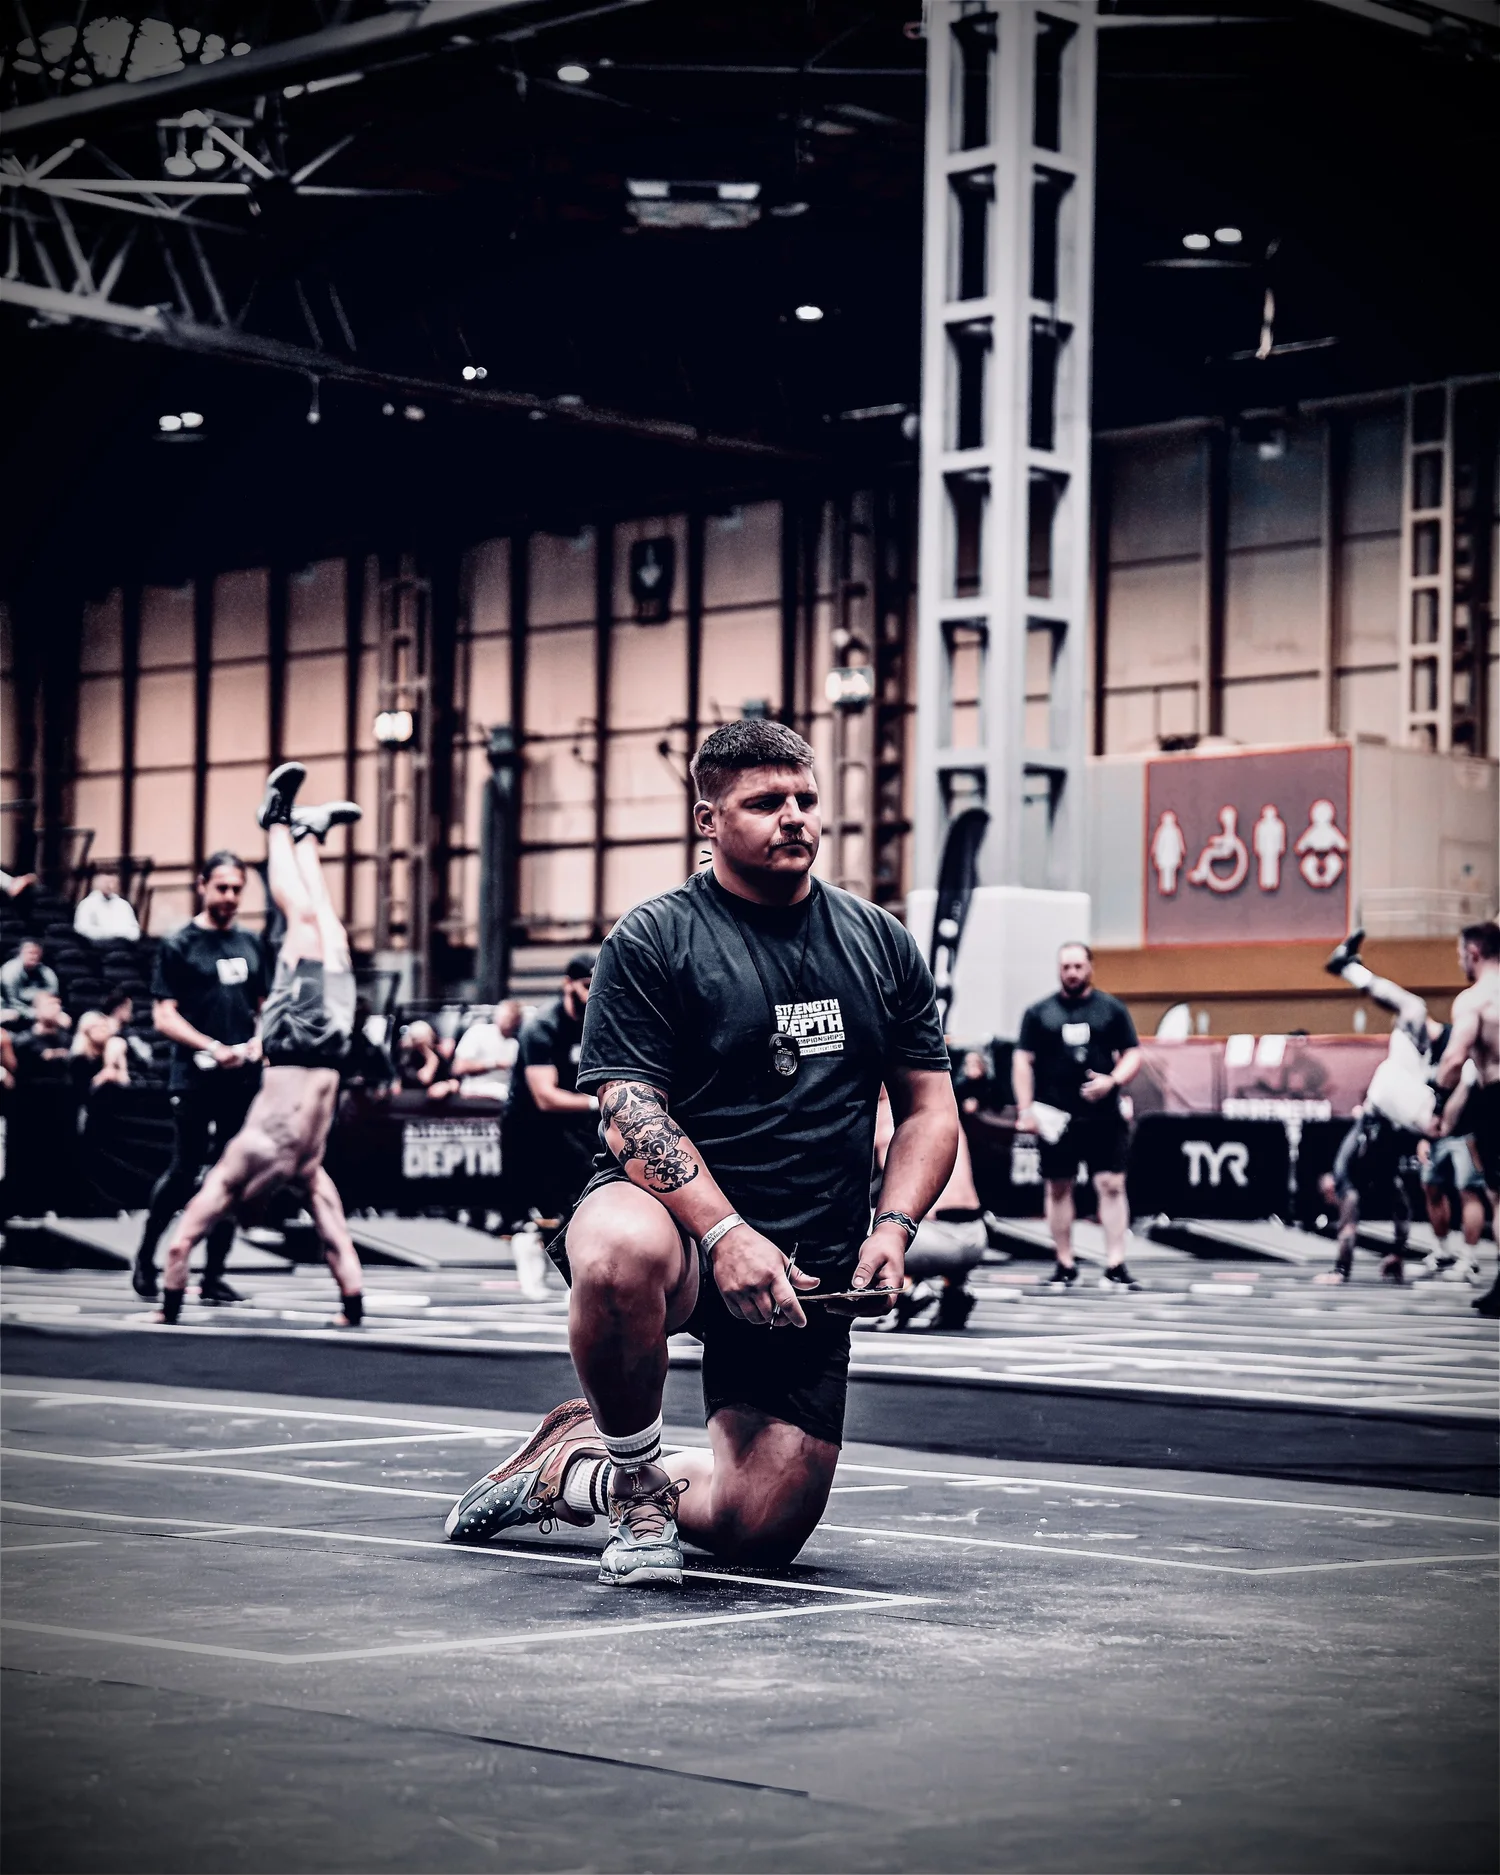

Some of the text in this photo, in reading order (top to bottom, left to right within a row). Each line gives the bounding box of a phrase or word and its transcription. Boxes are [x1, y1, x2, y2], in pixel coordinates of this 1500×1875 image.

[774, 998, 839, 1016] STRENGTH
[777, 1014, 844, 1037] DEPTH
[403, 1141, 501, 1177] DEPTH
[1182, 1141, 1249, 1187] TYR
